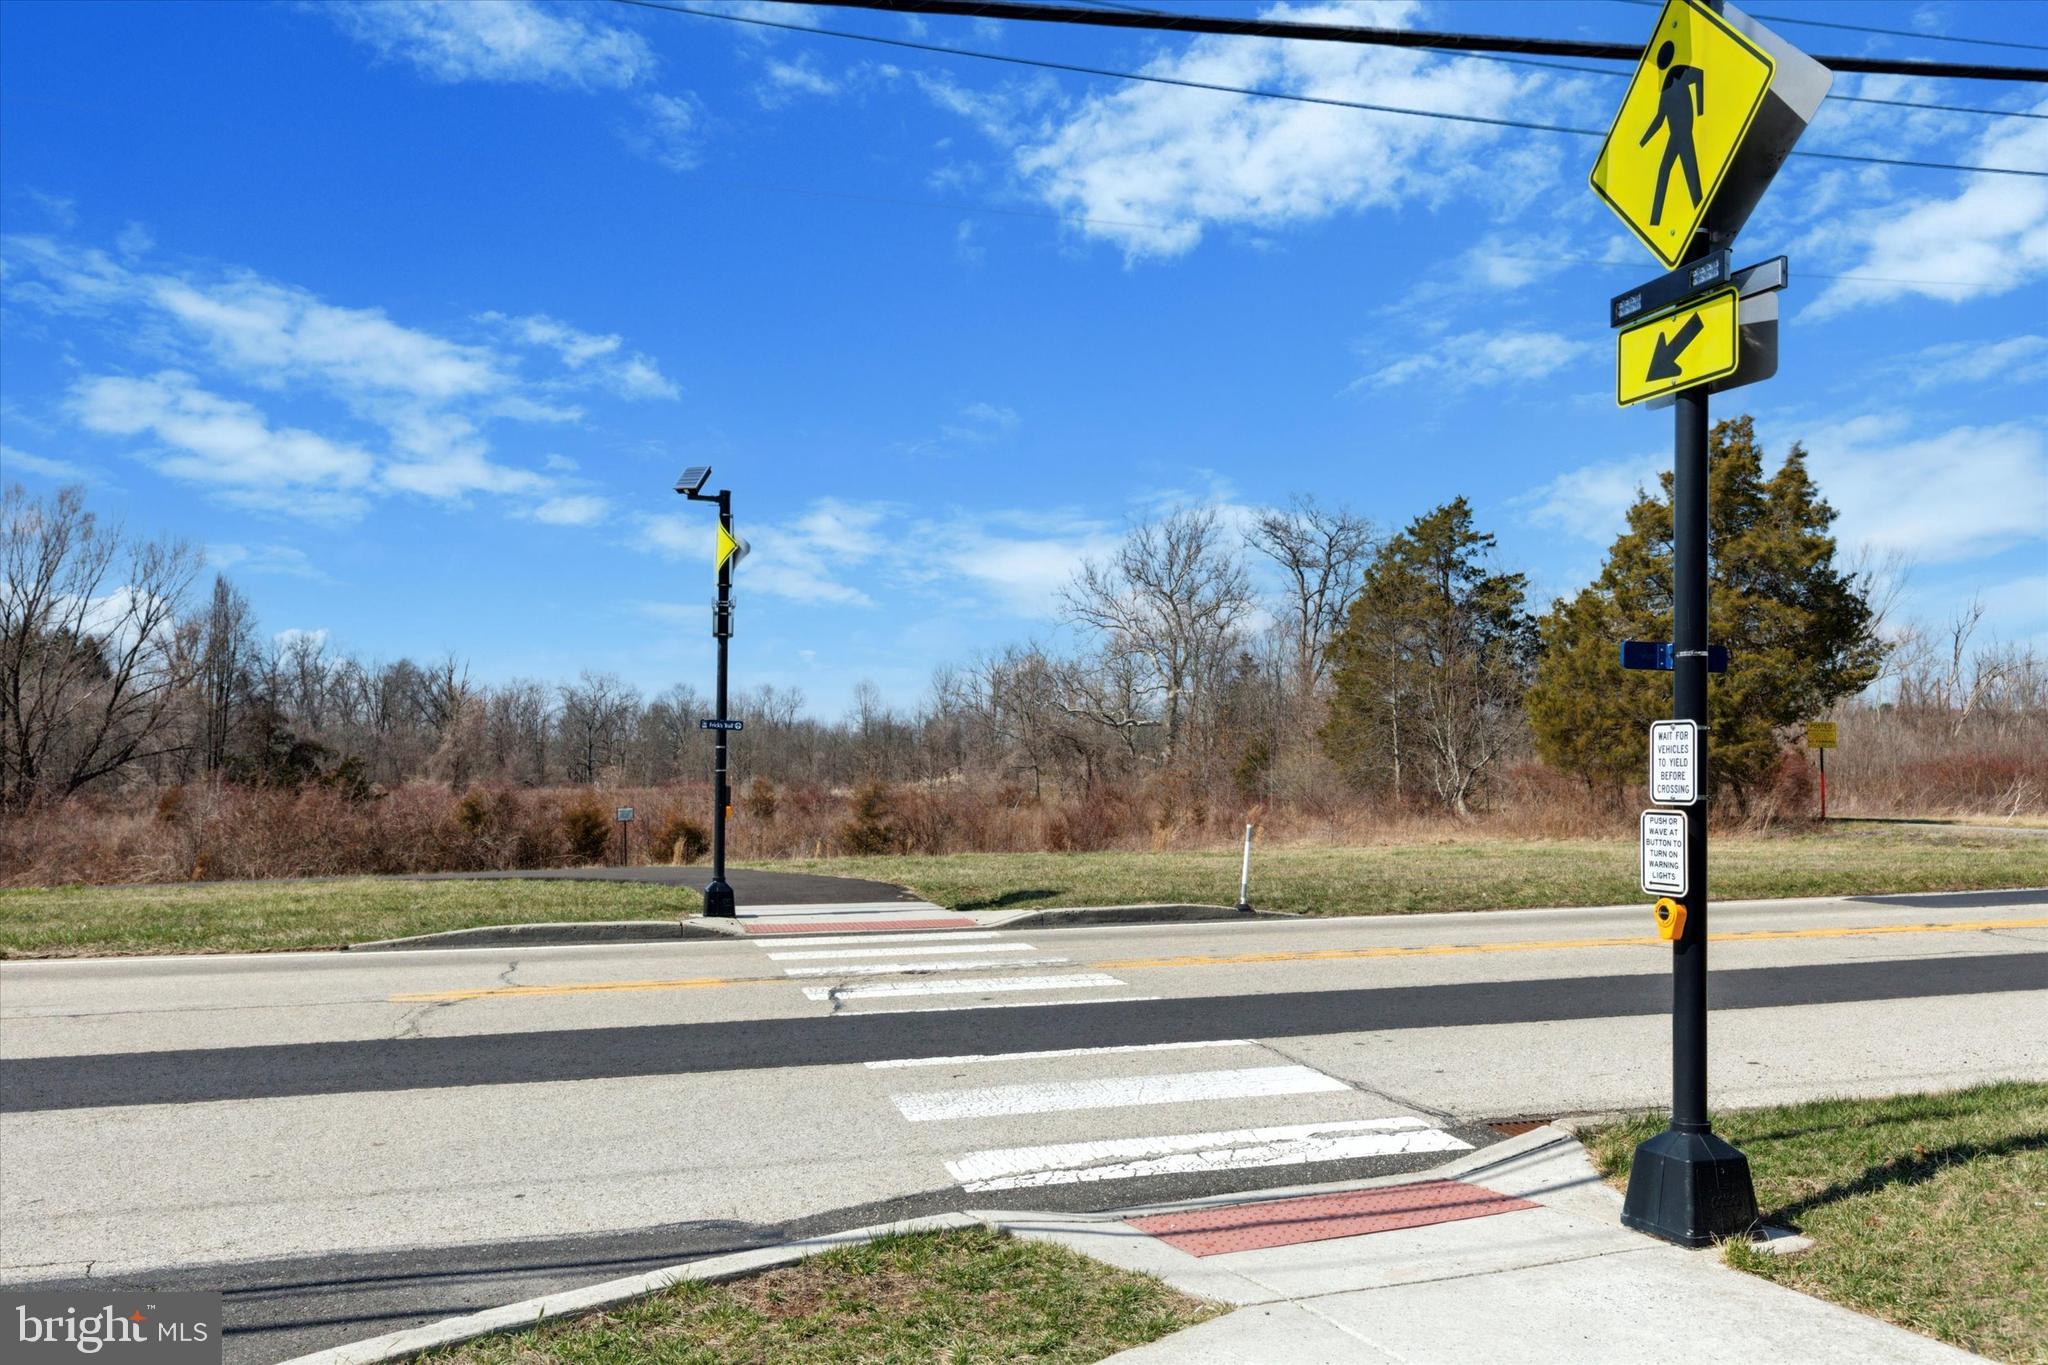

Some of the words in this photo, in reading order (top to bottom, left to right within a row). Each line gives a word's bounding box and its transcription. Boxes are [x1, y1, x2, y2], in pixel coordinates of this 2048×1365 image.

[1658, 731, 1672, 740] WAIT
[1676, 731, 1689, 740] FOR
[1657, 744, 1689, 754] VEHICLES
[1658, 758, 1666, 767] TO
[1669, 758, 1688, 767] YIELD
[1660, 771, 1686, 780] BEFORE
[1657, 784, 1689, 794] CROSSING
[1649, 816, 1667, 825] PUSH
[1668, 817, 1678, 825] OR
[1649, 827, 1668, 836] WAVE
[1646, 838, 1672, 847] BUTTON
[1673, 840, 1682, 848] TO
[1650, 849, 1667, 857] TURN
[1668, 850, 1678, 858] ON
[1649, 860, 1679, 870] WARNING
[1652, 871, 1676, 881] LIGHTS
